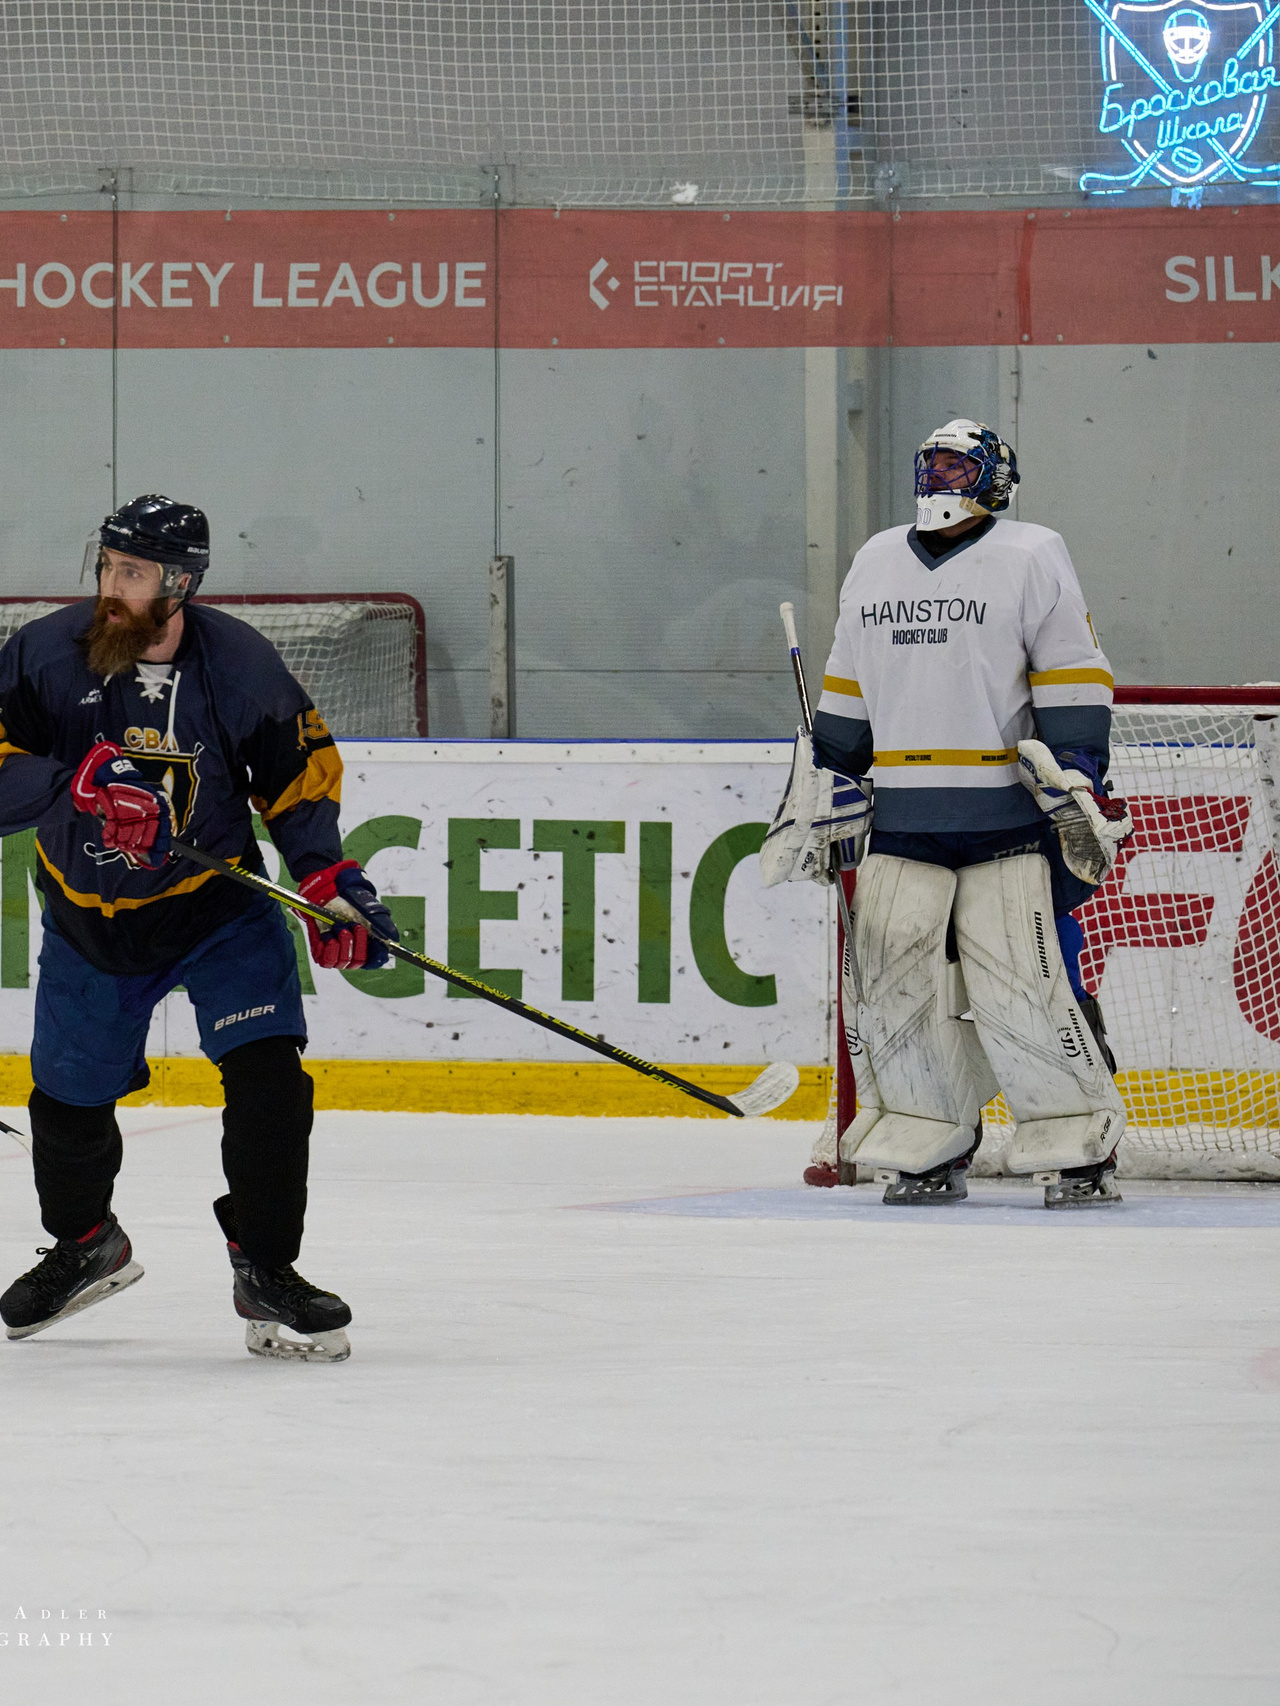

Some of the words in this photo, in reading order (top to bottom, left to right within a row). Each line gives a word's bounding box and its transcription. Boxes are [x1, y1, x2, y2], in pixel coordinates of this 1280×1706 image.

[1099, 57, 1280, 138] Бросковая
[1157, 112, 1246, 149] Школа
[253, 259, 487, 309] LEAGUE
[634, 284, 843, 311] СТАНЦИЯ
[1164, 255, 1280, 303] SILK
[861, 597, 987, 628] HANSTON
[892, 629, 926, 646] HOCKEY
[927, 627, 948, 644] CLUB
[1034, 911, 1051, 979] WARRIOR
[214, 1004, 276, 1032] BAUER
